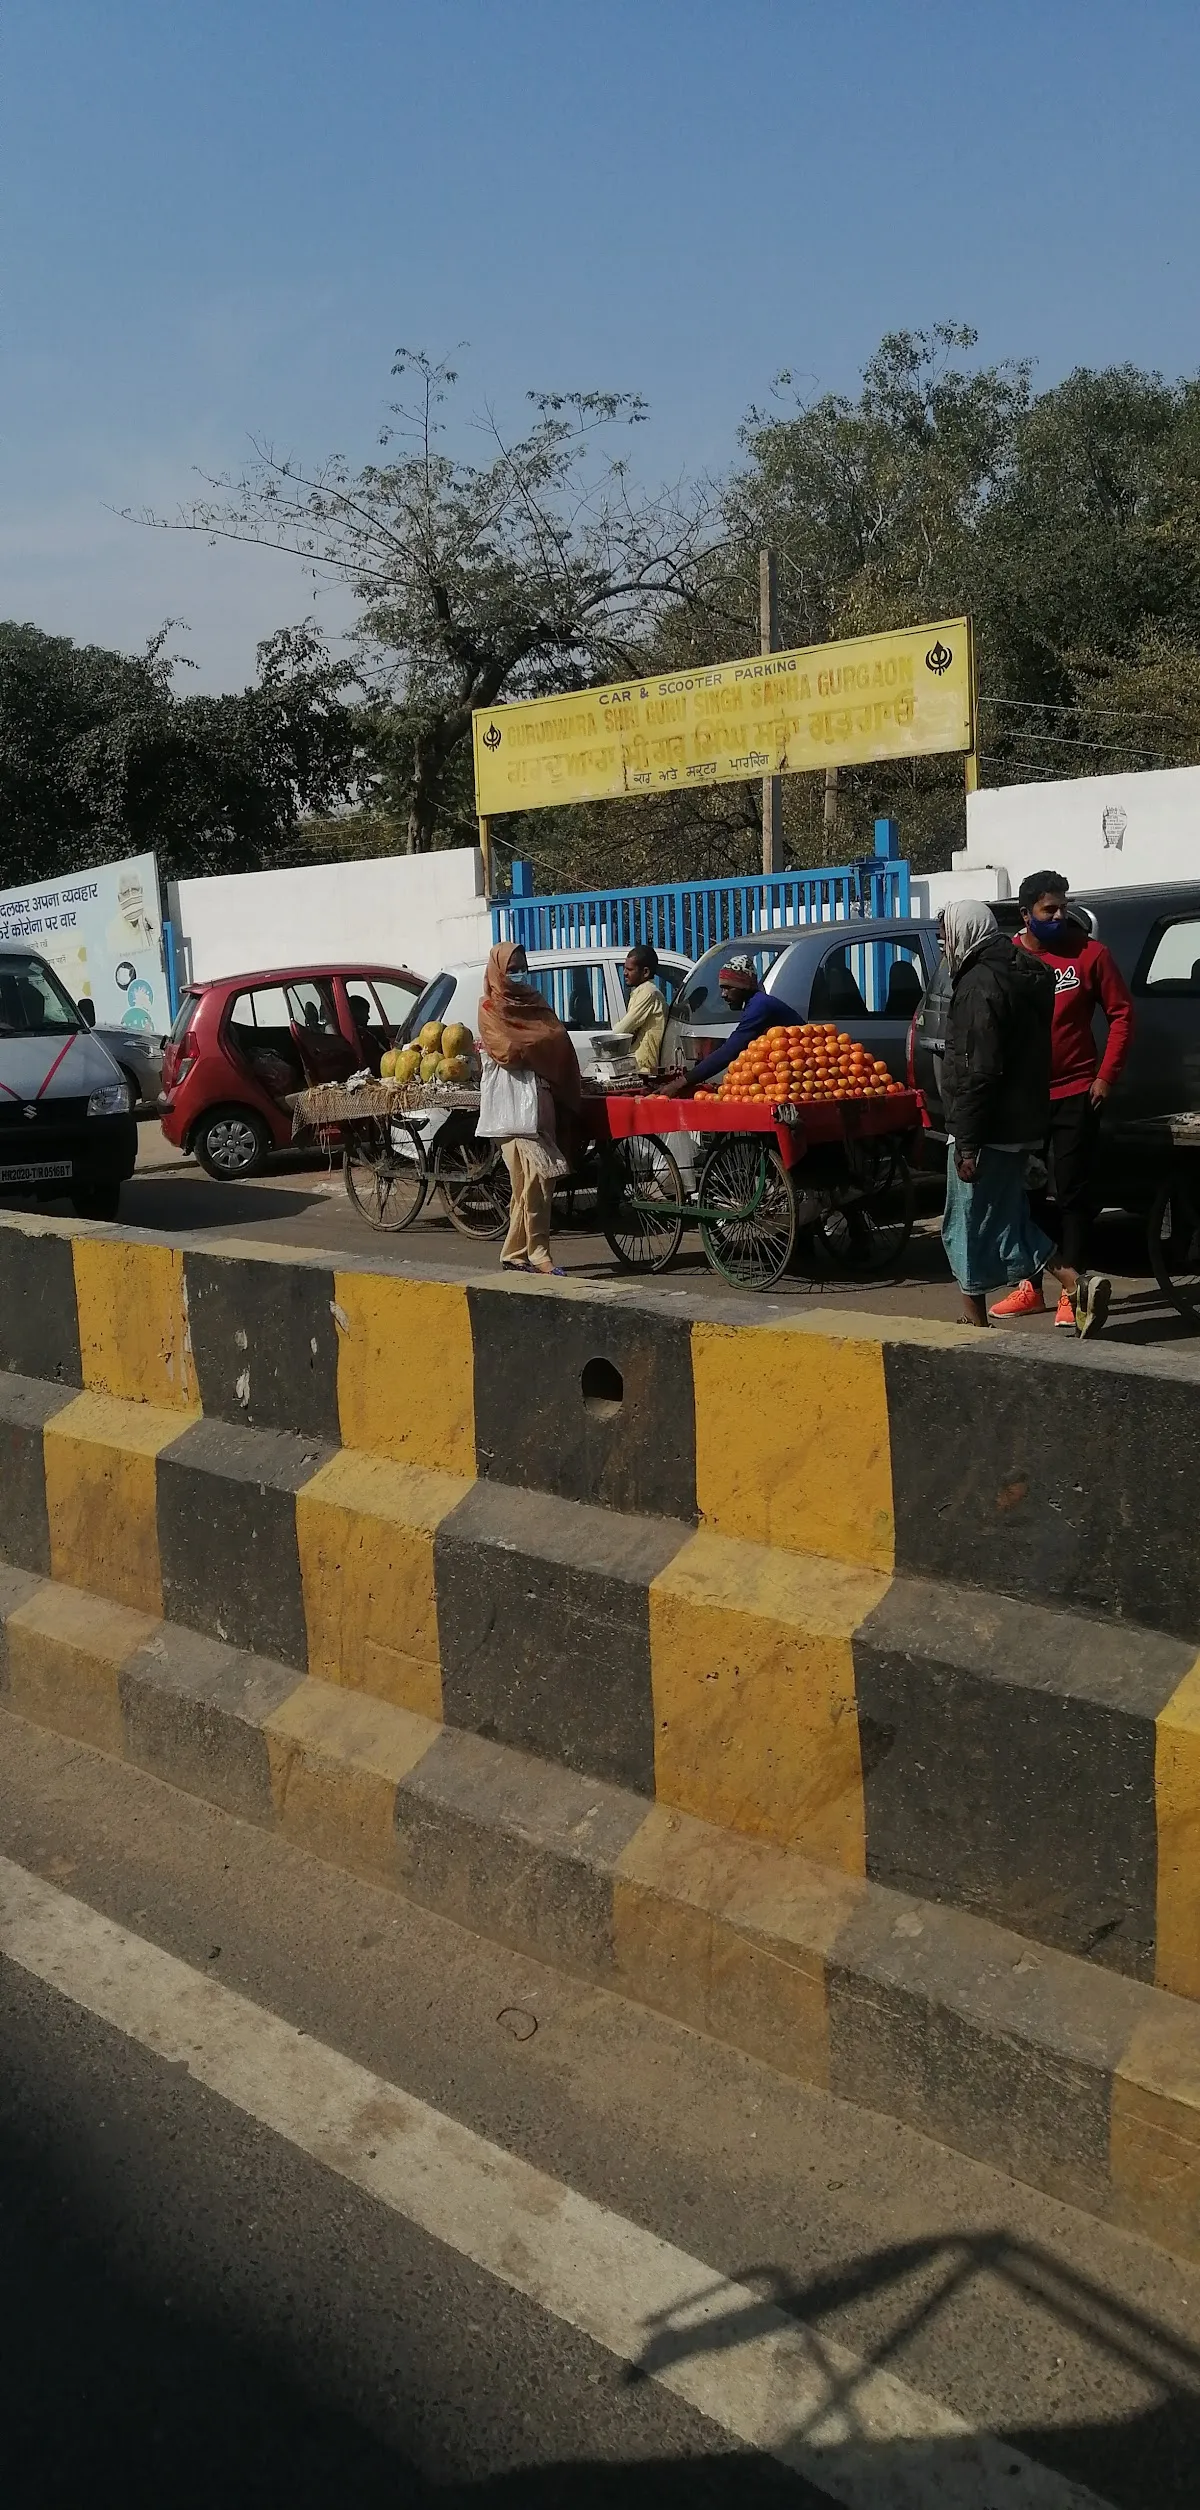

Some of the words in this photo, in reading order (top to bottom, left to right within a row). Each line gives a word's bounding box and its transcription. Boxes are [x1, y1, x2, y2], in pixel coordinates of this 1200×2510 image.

[507, 712, 598, 748] GURUDWARA
[604, 704, 641, 733] SHRI
[646, 696, 687, 726] GURU
[694, 682, 743, 715] SINGH
[750, 673, 812, 709] SABHA
[818, 652, 914, 698] GURGAON
[598, 690, 631, 706] CAR
[640, 686, 649, 699] &
[658, 672, 723, 697] SCOOTER
[734, 659, 797, 682] PARKING
[633, 772, 652, 785] ਕਾਰ
[0, 898, 30, 918] दलकर
[32, 892, 60, 911] अपना
[61, 883, 99, 903] व्यवहार
[11, 917, 43, 938] कोरोना
[45, 915, 59, 931] पर
[60, 911, 77, 928] वार
